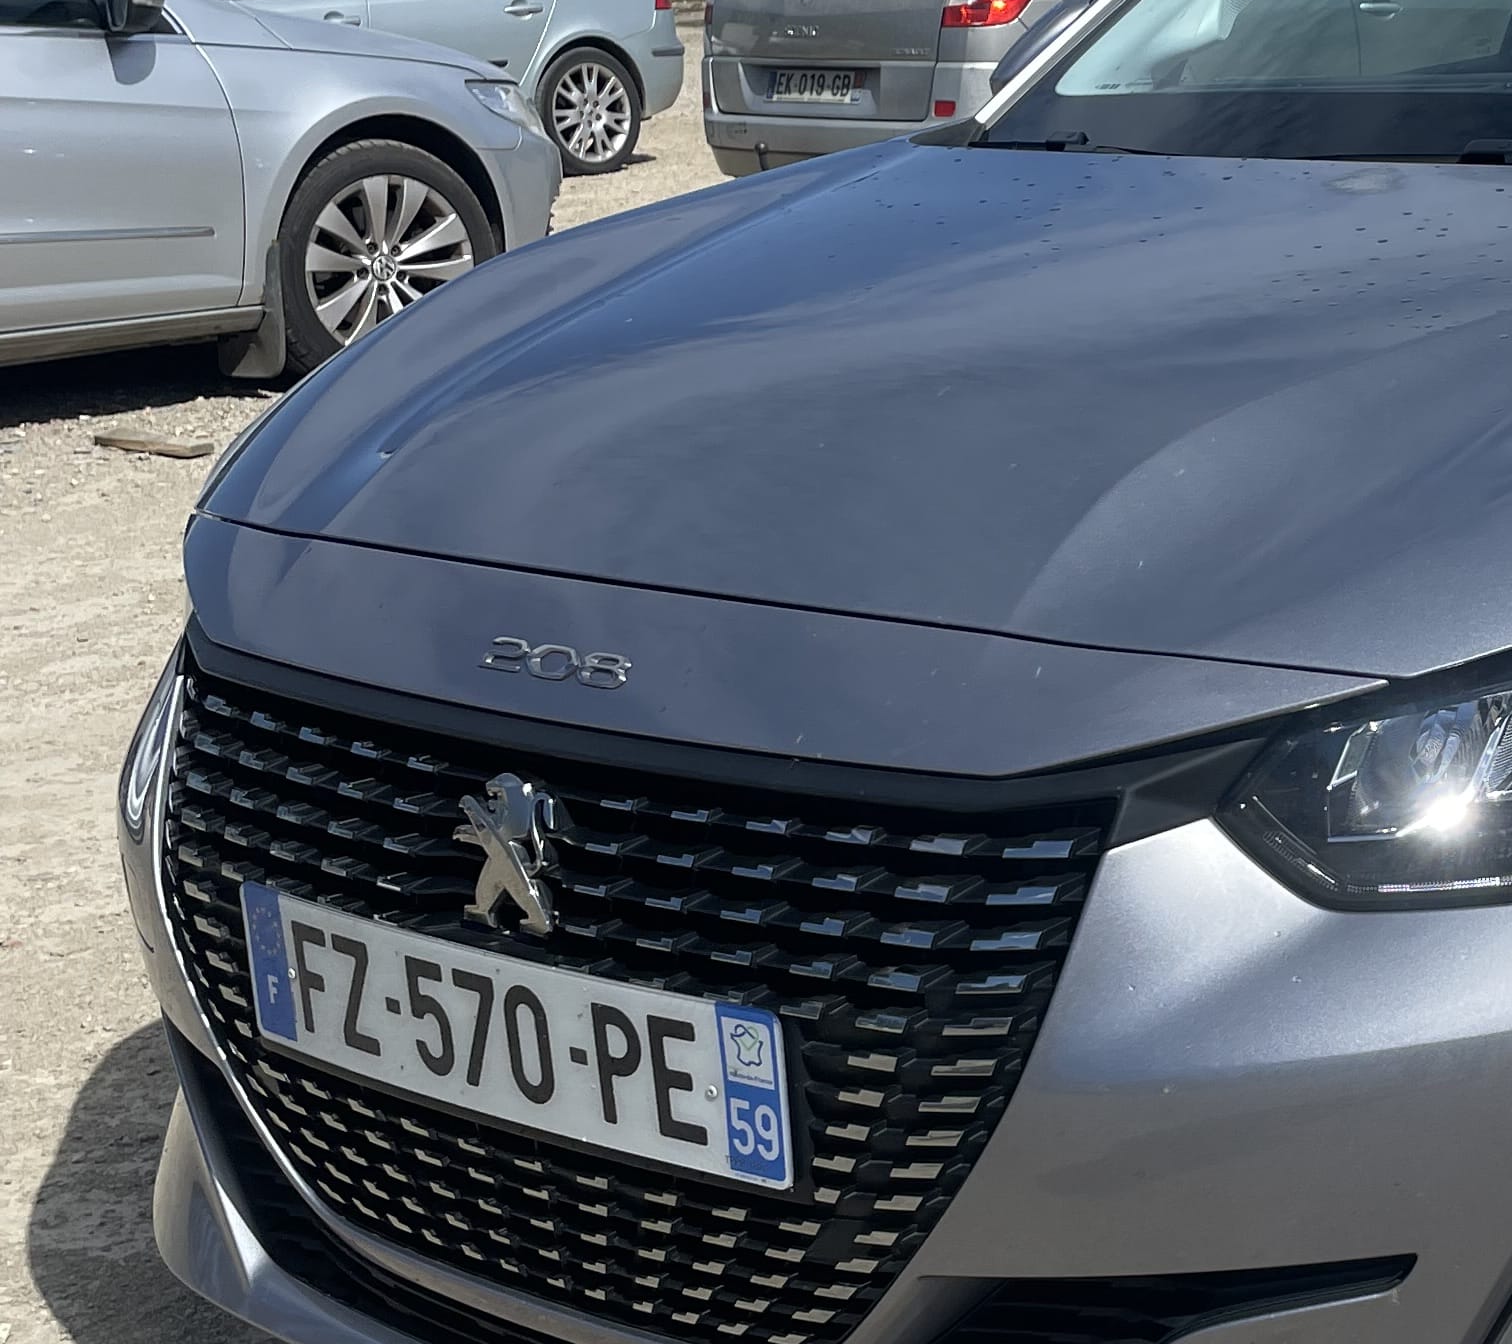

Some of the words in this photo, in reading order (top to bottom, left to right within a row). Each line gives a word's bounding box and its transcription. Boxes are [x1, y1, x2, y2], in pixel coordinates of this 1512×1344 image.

[477, 635, 633, 690] 208
[267, 974, 279, 1004] F
[291, 919, 709, 1147] FZ-570-PE
[730, 1097, 780, 1161] 59
